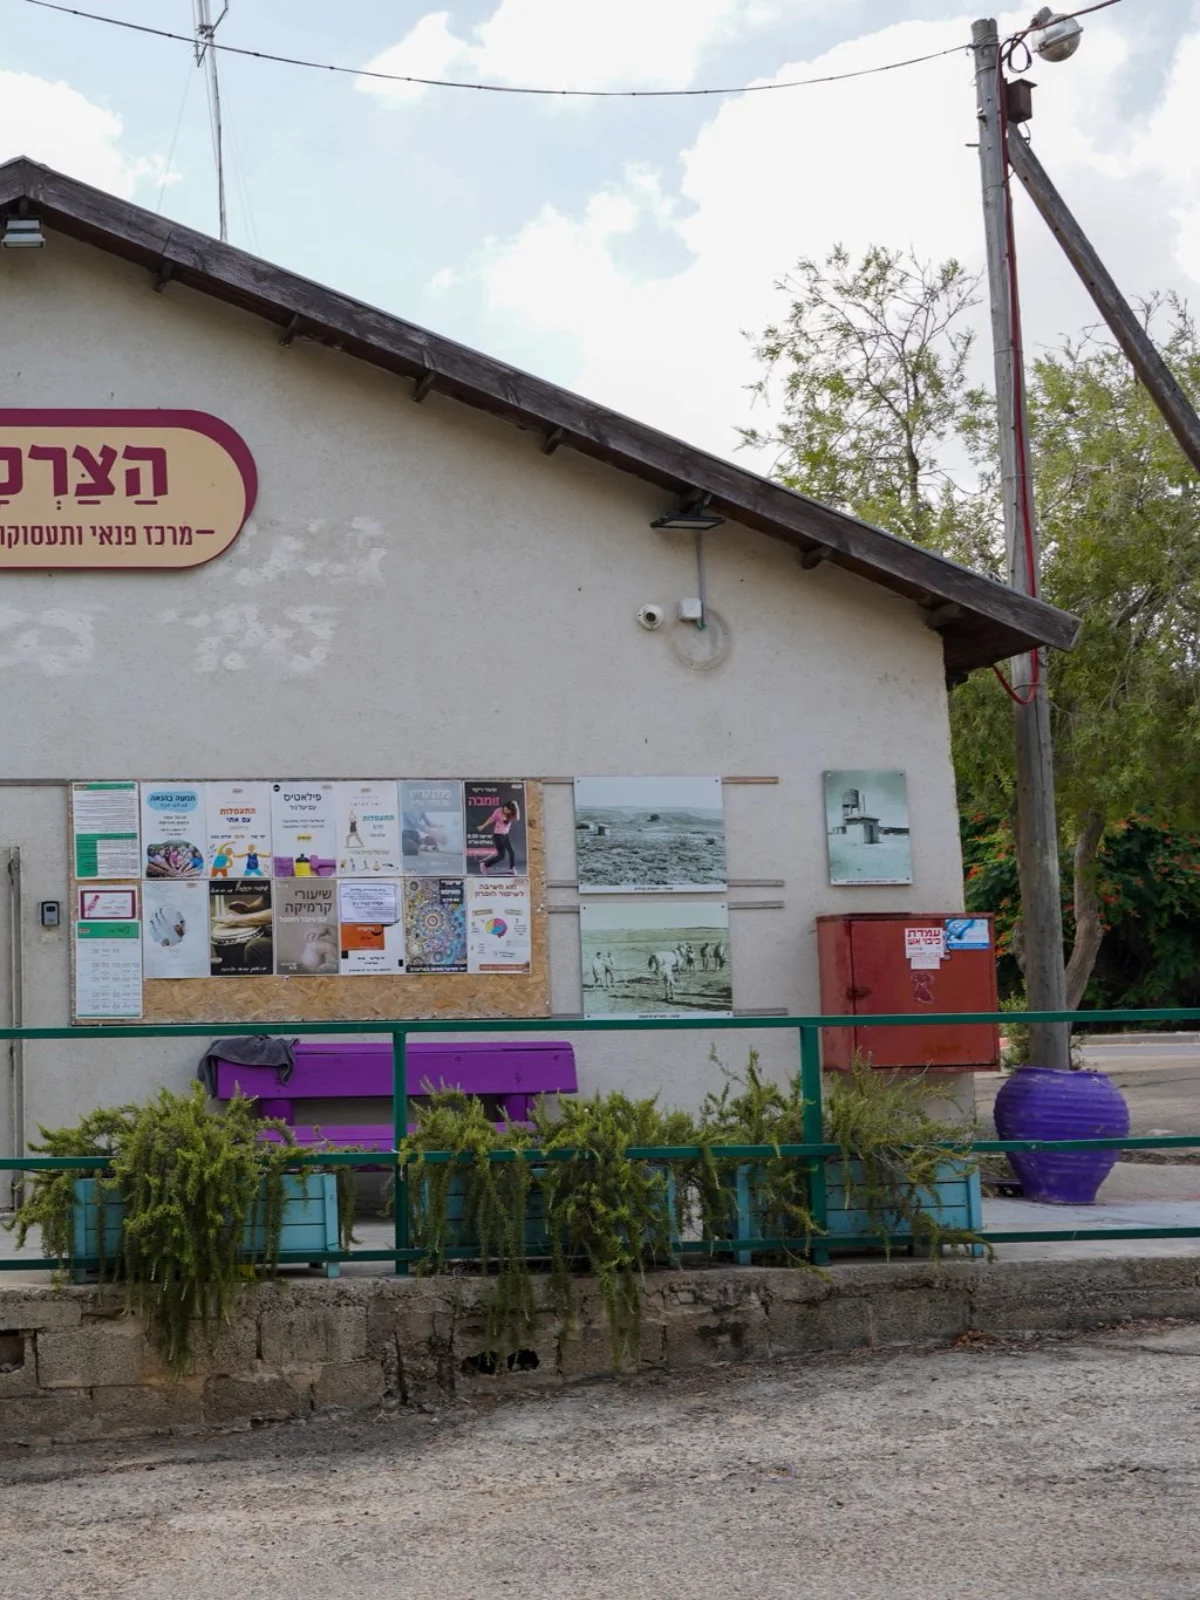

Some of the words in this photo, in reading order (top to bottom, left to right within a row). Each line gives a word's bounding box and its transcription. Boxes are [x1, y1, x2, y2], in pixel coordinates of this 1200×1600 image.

[90, 525, 137, 546] פנאי
[143, 525, 193, 546] מרכז
[283, 792, 322, 802] פילאטיס
[468, 796, 500, 807] זומבה
[219, 807, 257, 815] התעמלות
[294, 889, 333, 900] שיעורי
[285, 902, 333, 916] קרמיקה
[907, 929, 941, 938] עמדת
